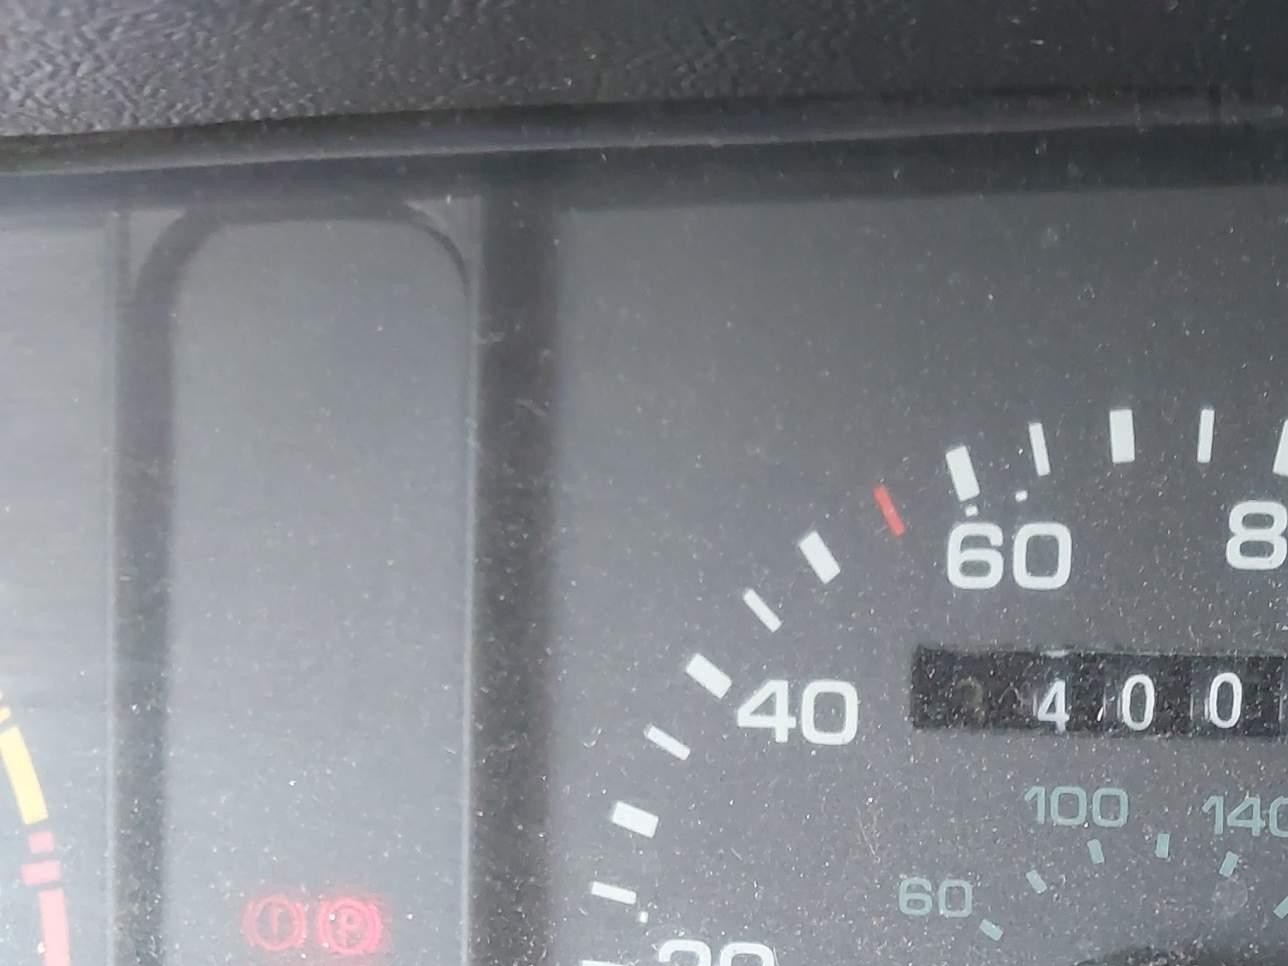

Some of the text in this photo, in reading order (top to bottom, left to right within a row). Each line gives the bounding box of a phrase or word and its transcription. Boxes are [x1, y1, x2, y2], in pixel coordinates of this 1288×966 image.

[946, 521, 1072, 590] 60
[737, 680, 859, 745] 40
[1024, 785, 1130, 828] 100
[899, 877, 973, 918] 60
